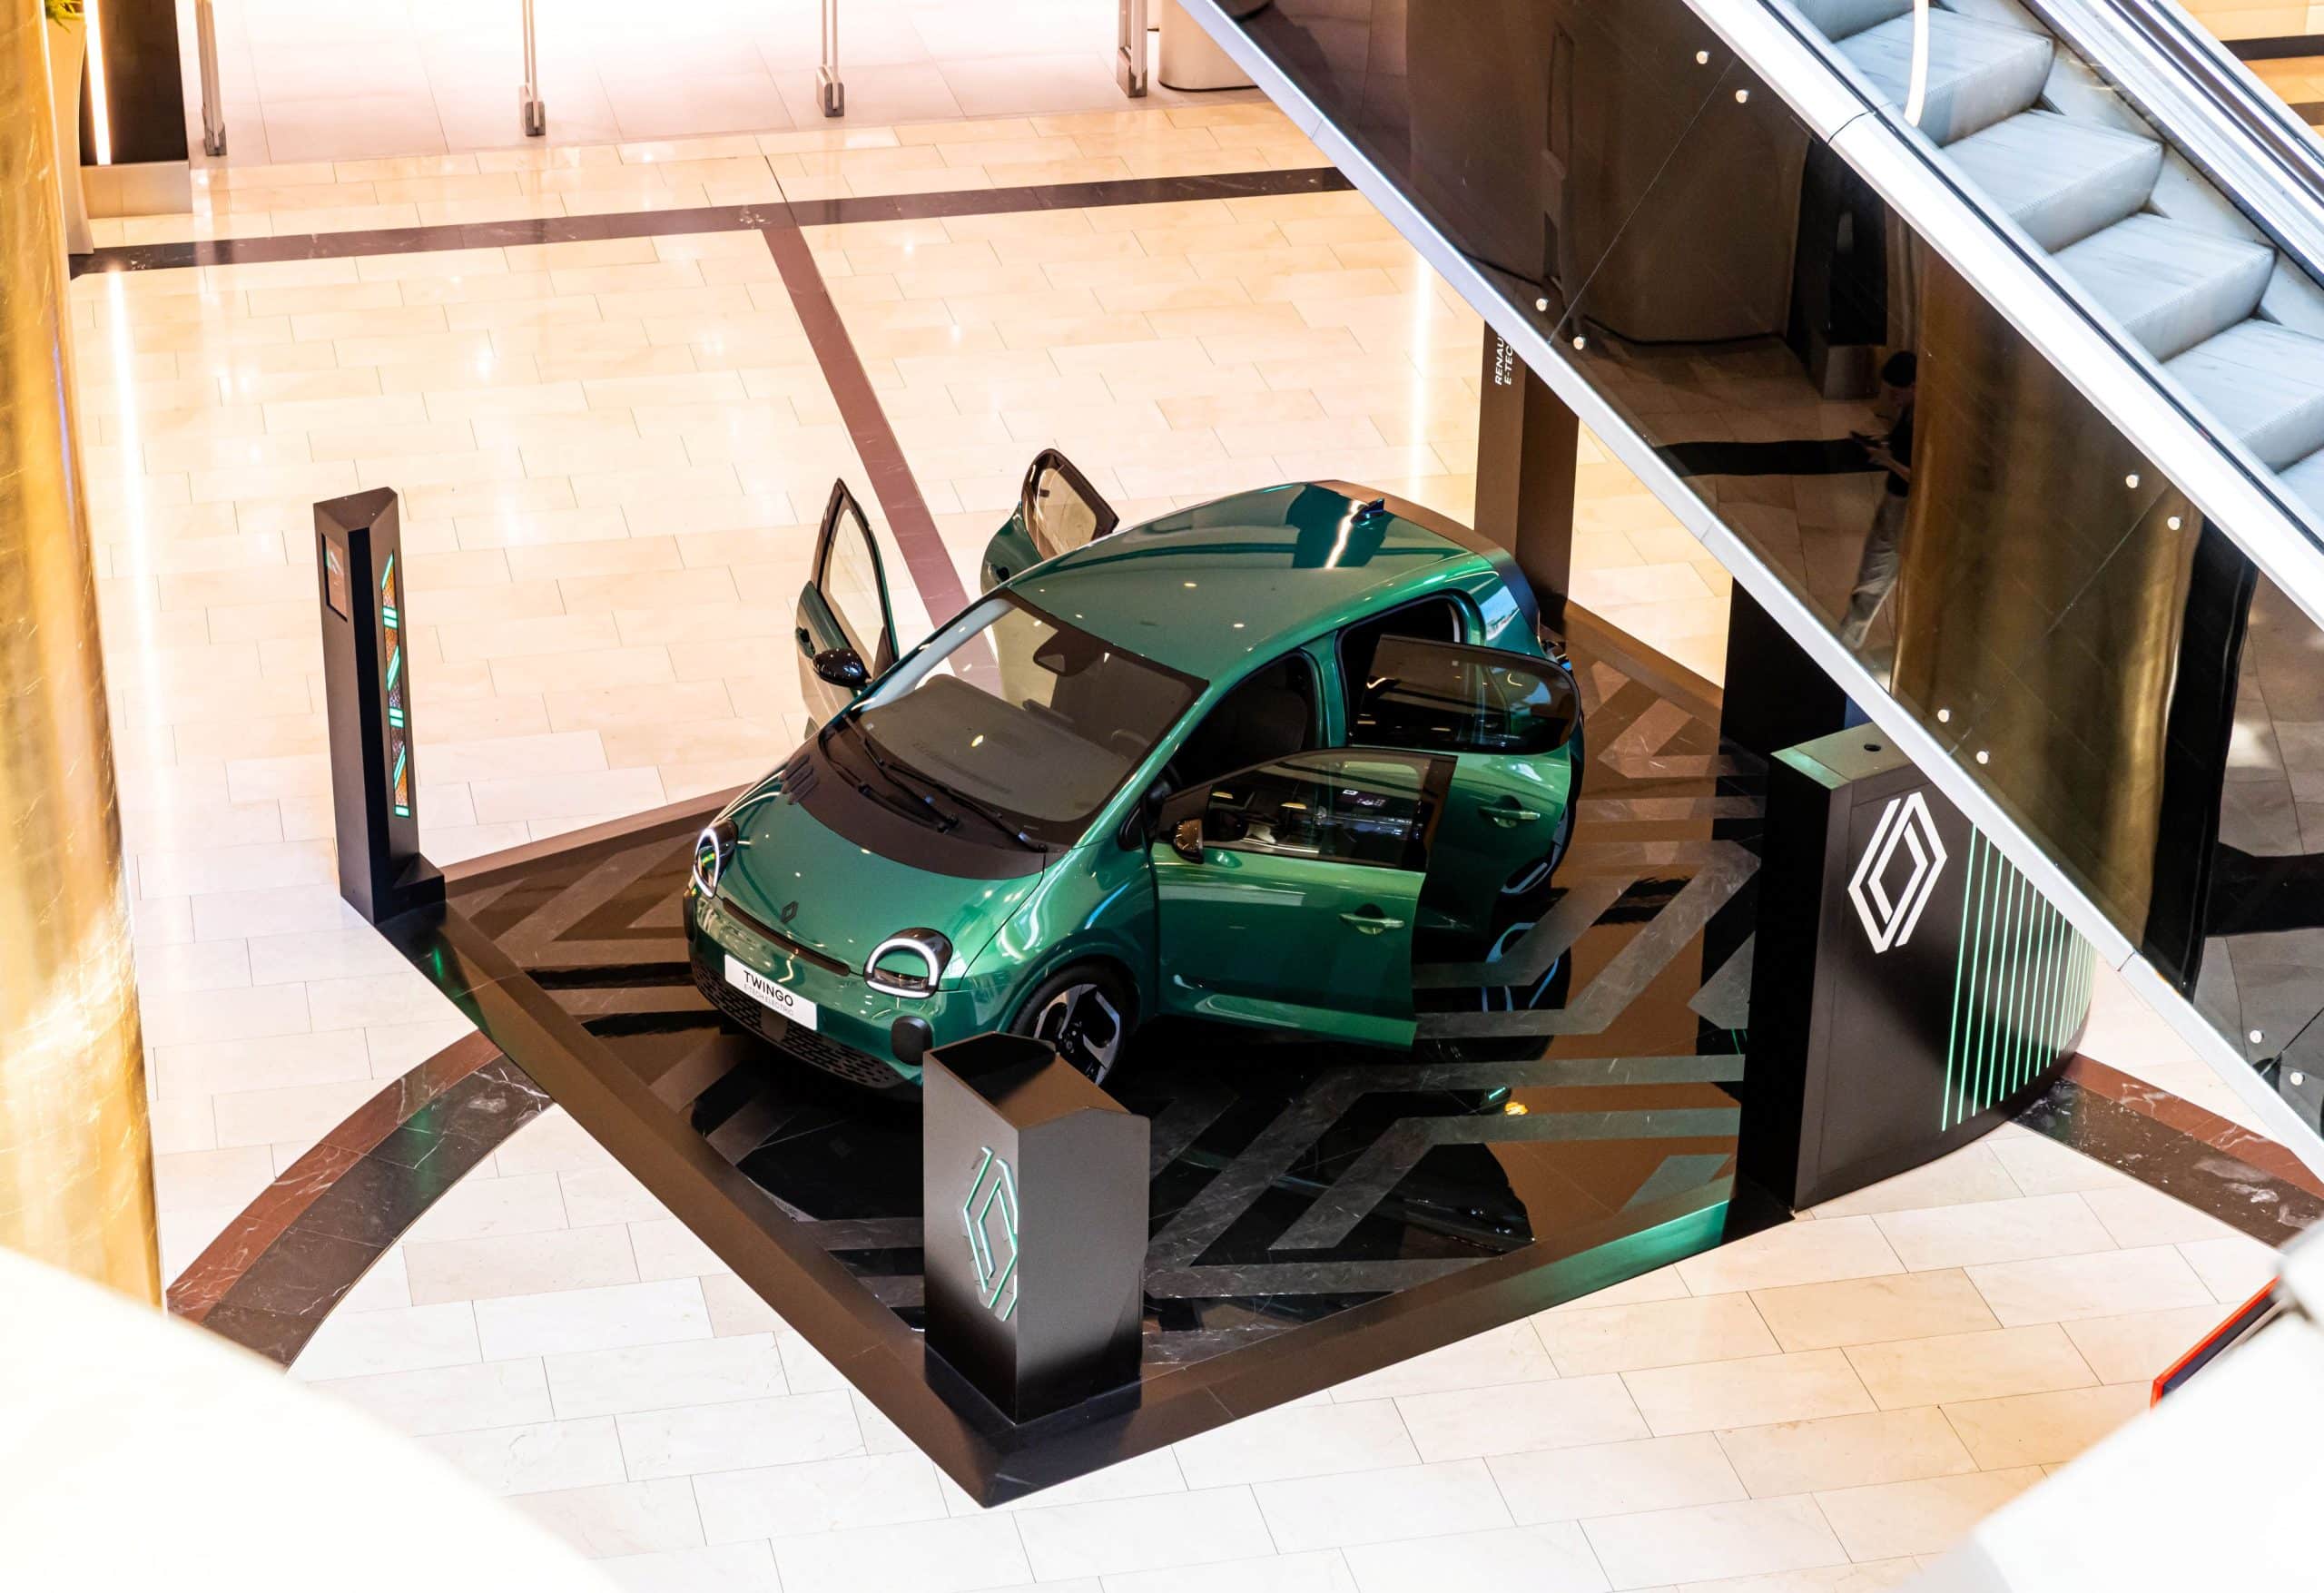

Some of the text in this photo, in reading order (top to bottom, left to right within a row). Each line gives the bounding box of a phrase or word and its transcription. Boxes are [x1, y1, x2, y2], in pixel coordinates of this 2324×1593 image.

[1495, 337, 1504, 385] RENAU
[1504, 345, 1513, 385] E-TEC
[743, 969, 794, 1007] TWINGO
